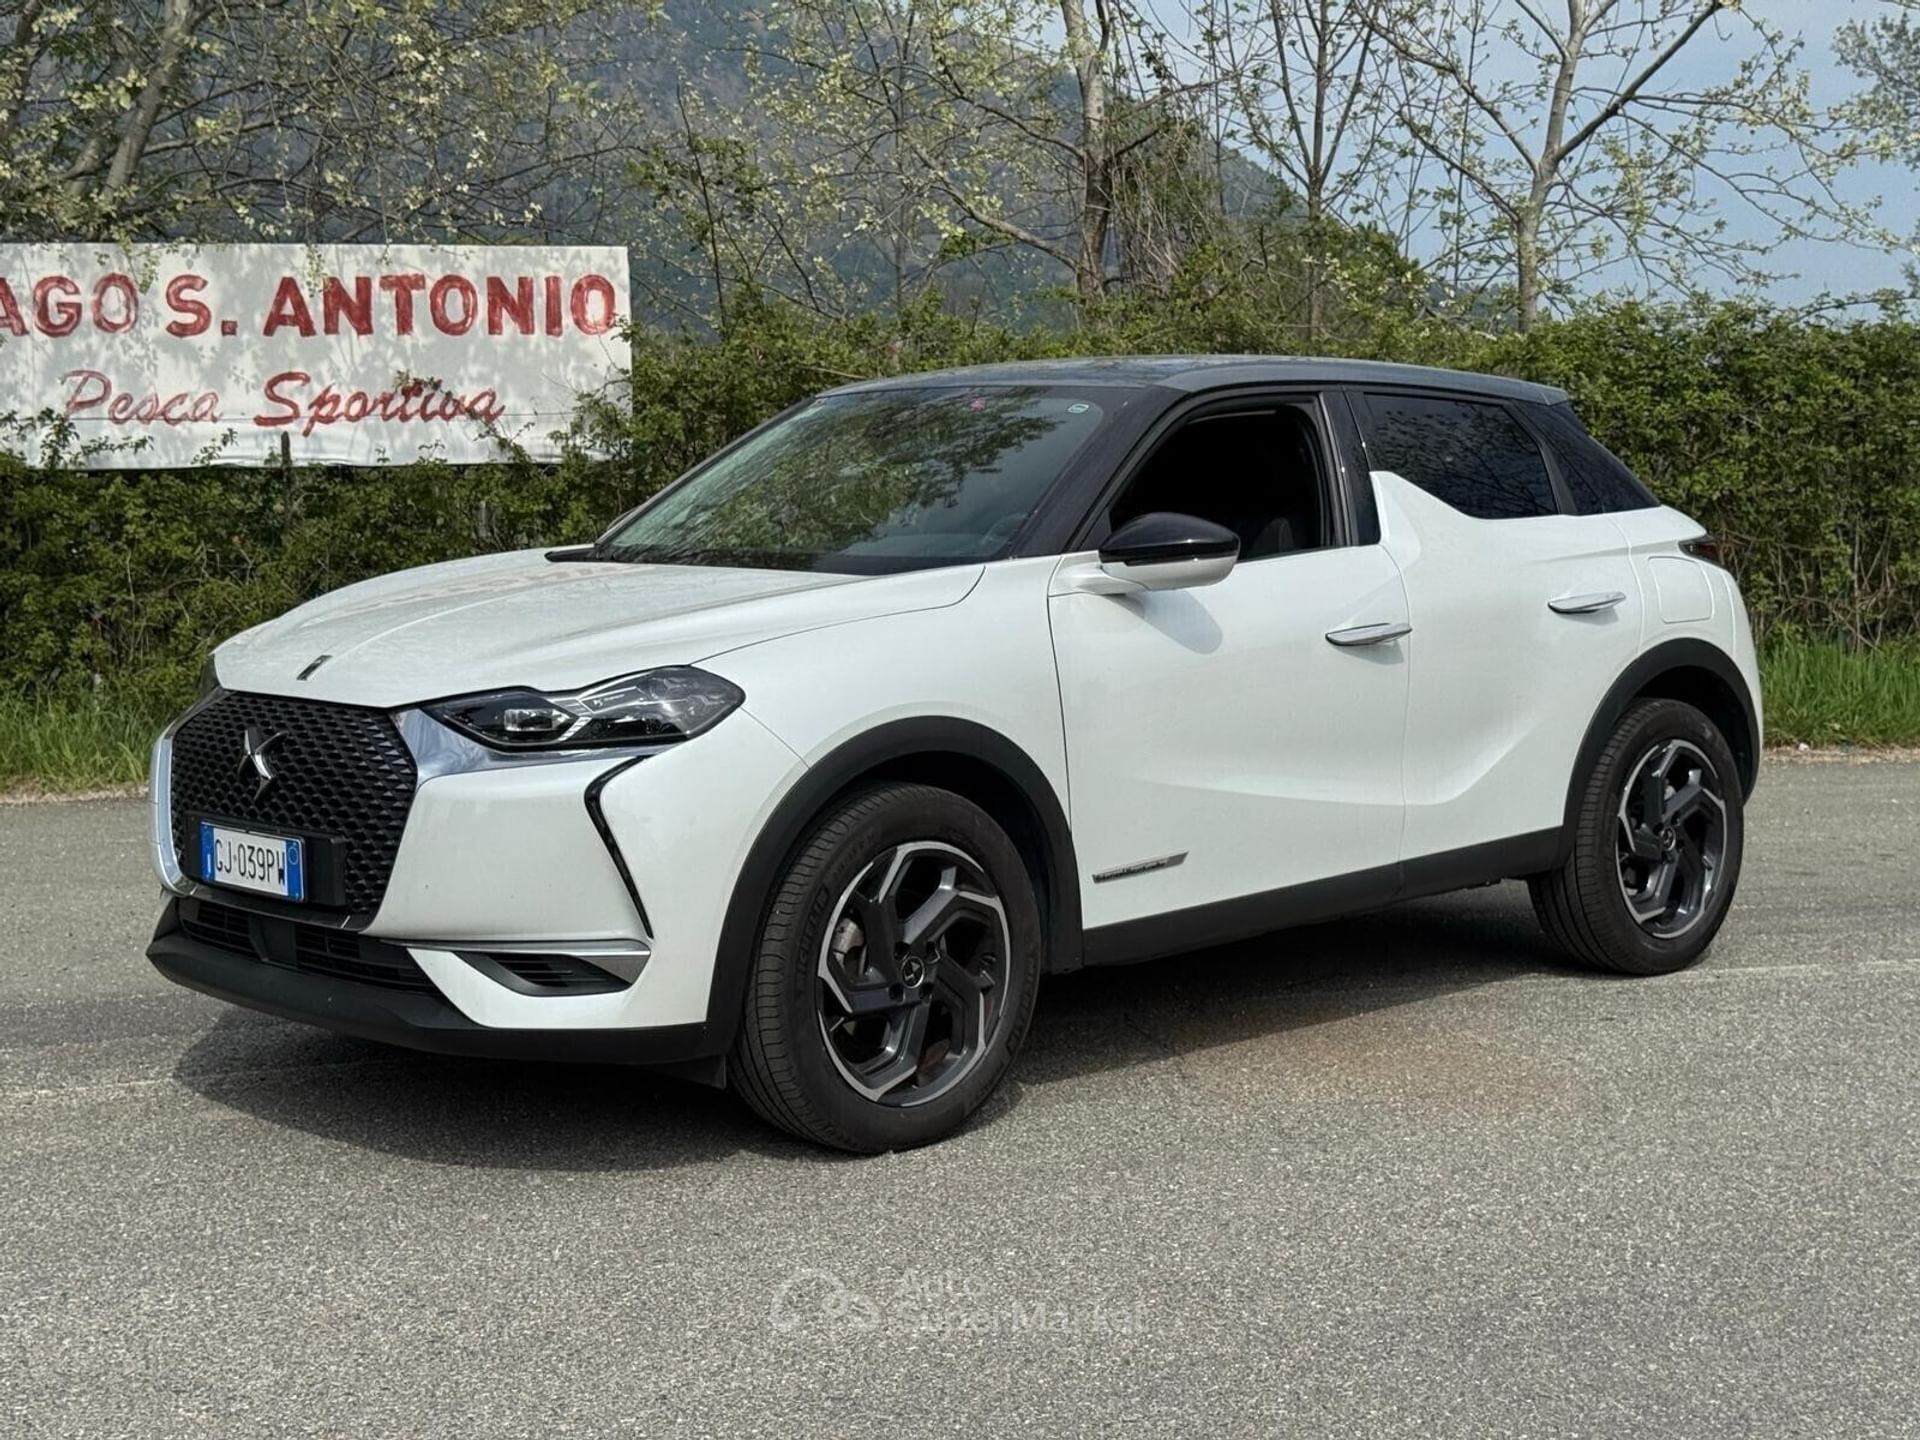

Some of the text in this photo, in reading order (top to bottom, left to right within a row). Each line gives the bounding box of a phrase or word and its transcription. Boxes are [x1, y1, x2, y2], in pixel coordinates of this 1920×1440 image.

[166, 275, 238, 337] S.
[263, 273, 618, 337] ANTONIO
[62, 370, 505, 437] Pesca Sportiva
